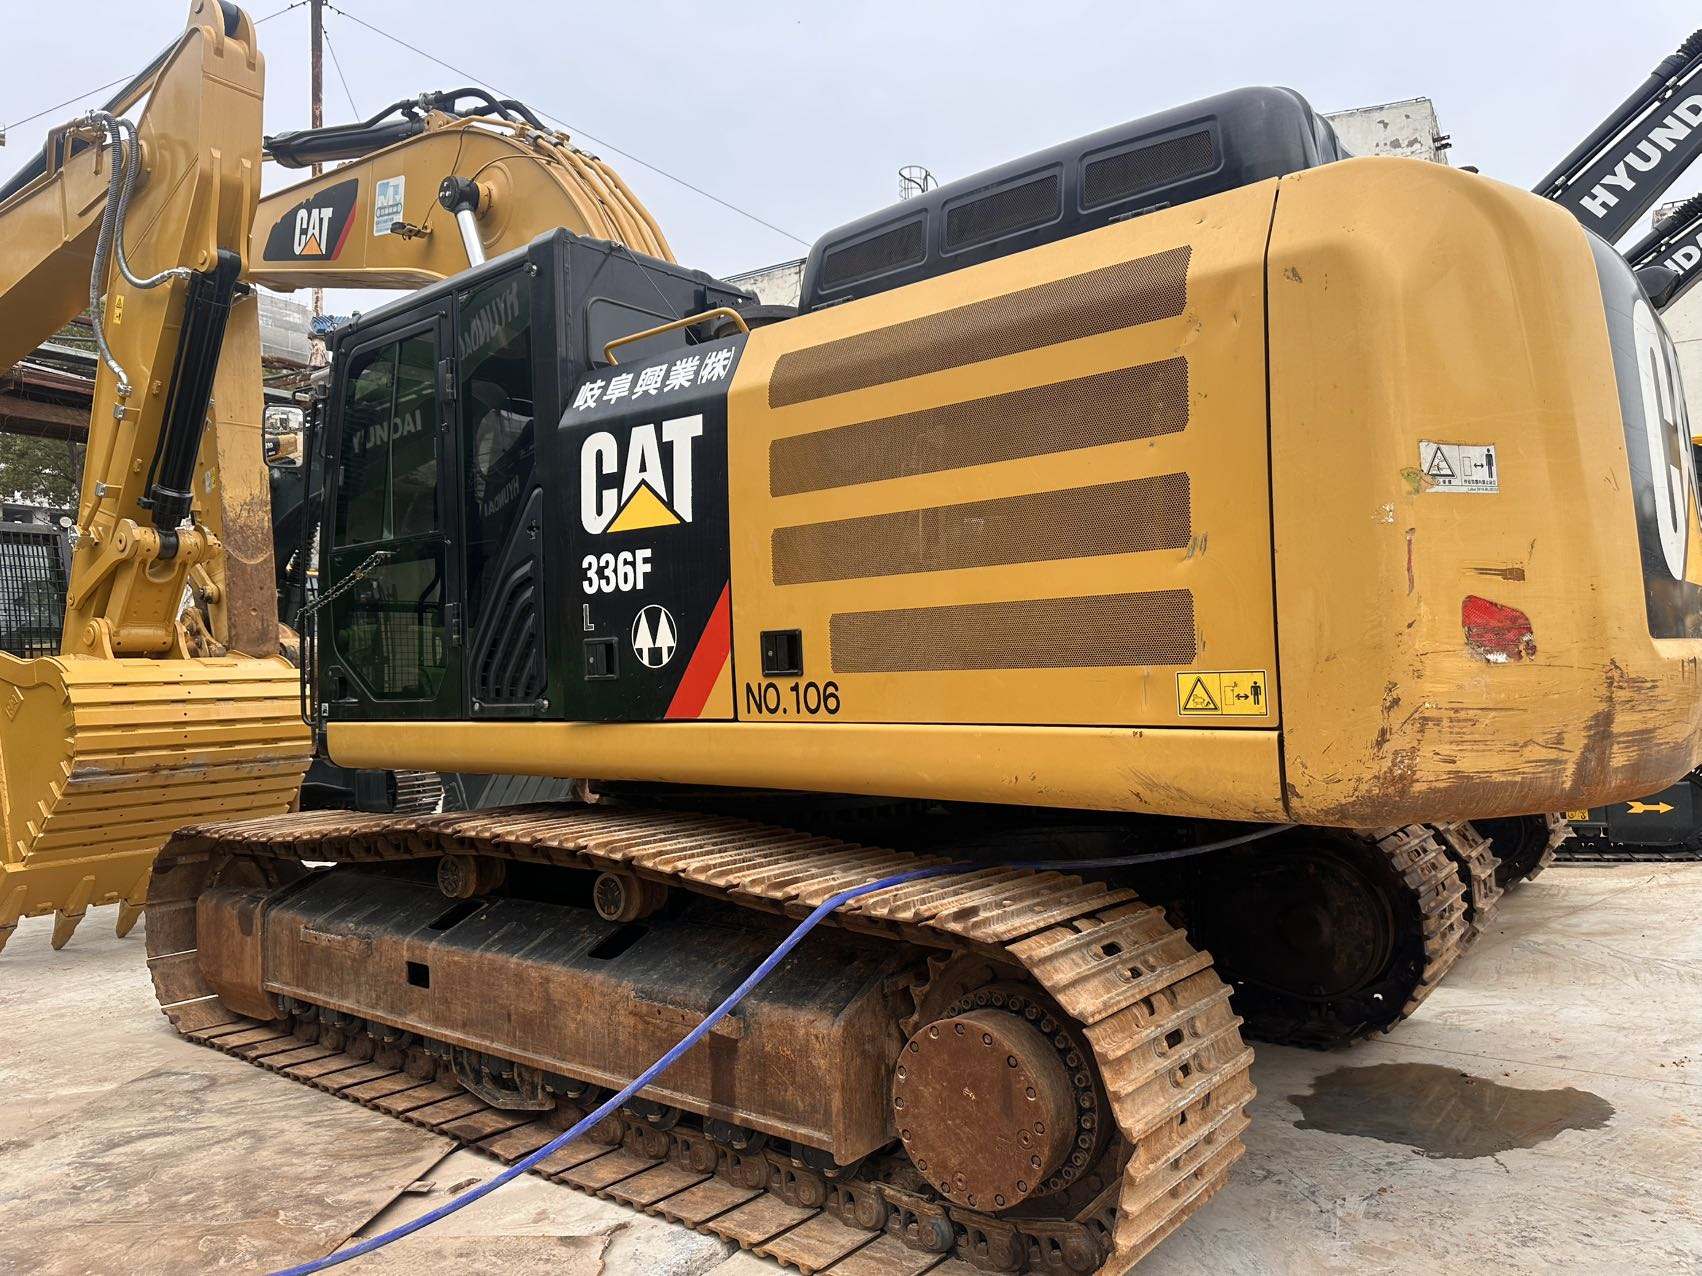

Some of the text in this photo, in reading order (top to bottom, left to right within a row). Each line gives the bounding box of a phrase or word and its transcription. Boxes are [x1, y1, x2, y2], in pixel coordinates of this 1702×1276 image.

[1579, 93, 1702, 219] HYUND
[294, 207, 333, 255] CAT
[580, 413, 704, 535] CAT
[582, 548, 652, 595] 336F
[582, 604, 595, 631] L
